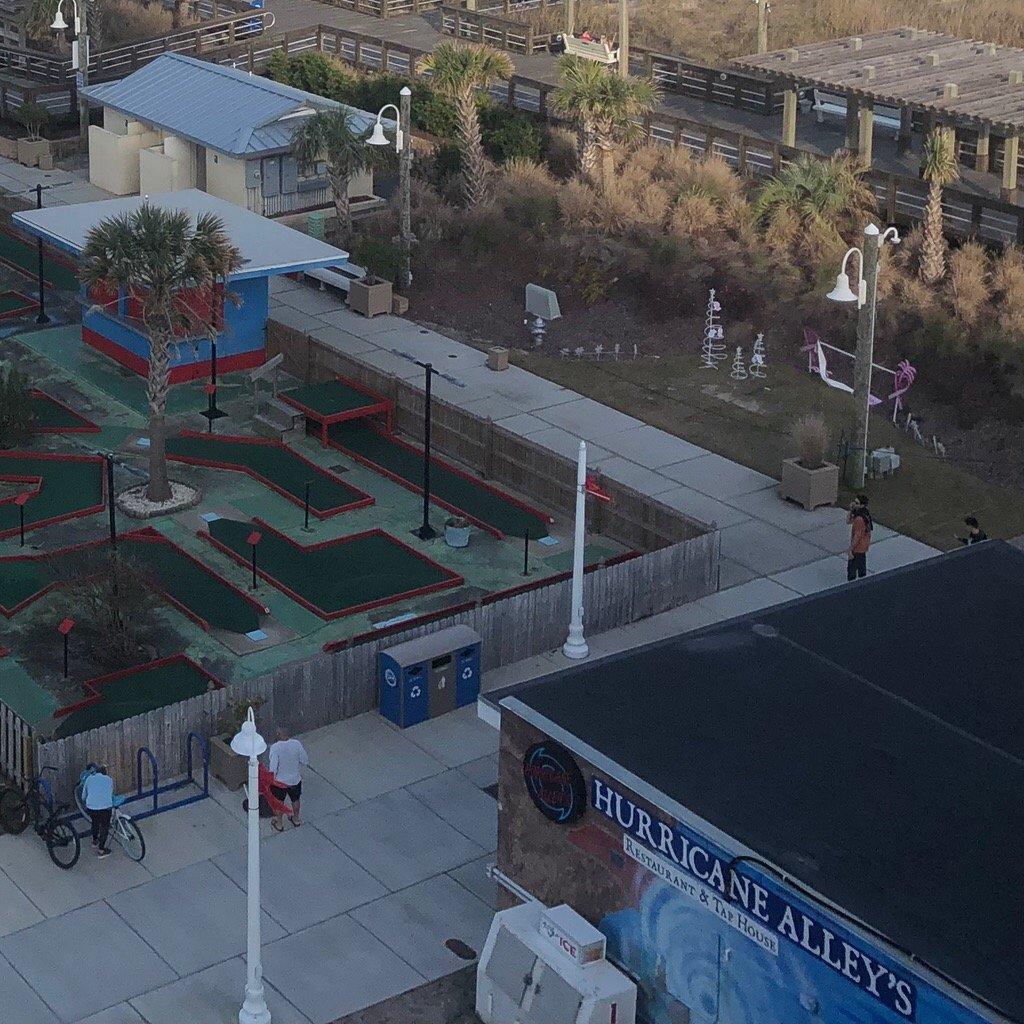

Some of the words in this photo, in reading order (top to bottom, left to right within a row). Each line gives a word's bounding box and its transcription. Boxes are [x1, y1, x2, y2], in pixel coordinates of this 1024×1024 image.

[559, 936, 577, 958] ICE
[594, 779, 769, 923] HURRICANE
[778, 905, 912, 1016] ALLEY'S
[626, 838, 696, 896] RESTAURANT
[699, 888, 710, 906] &
[712, 896, 734, 922] TAP
[737, 914, 777, 951] HOUSE
